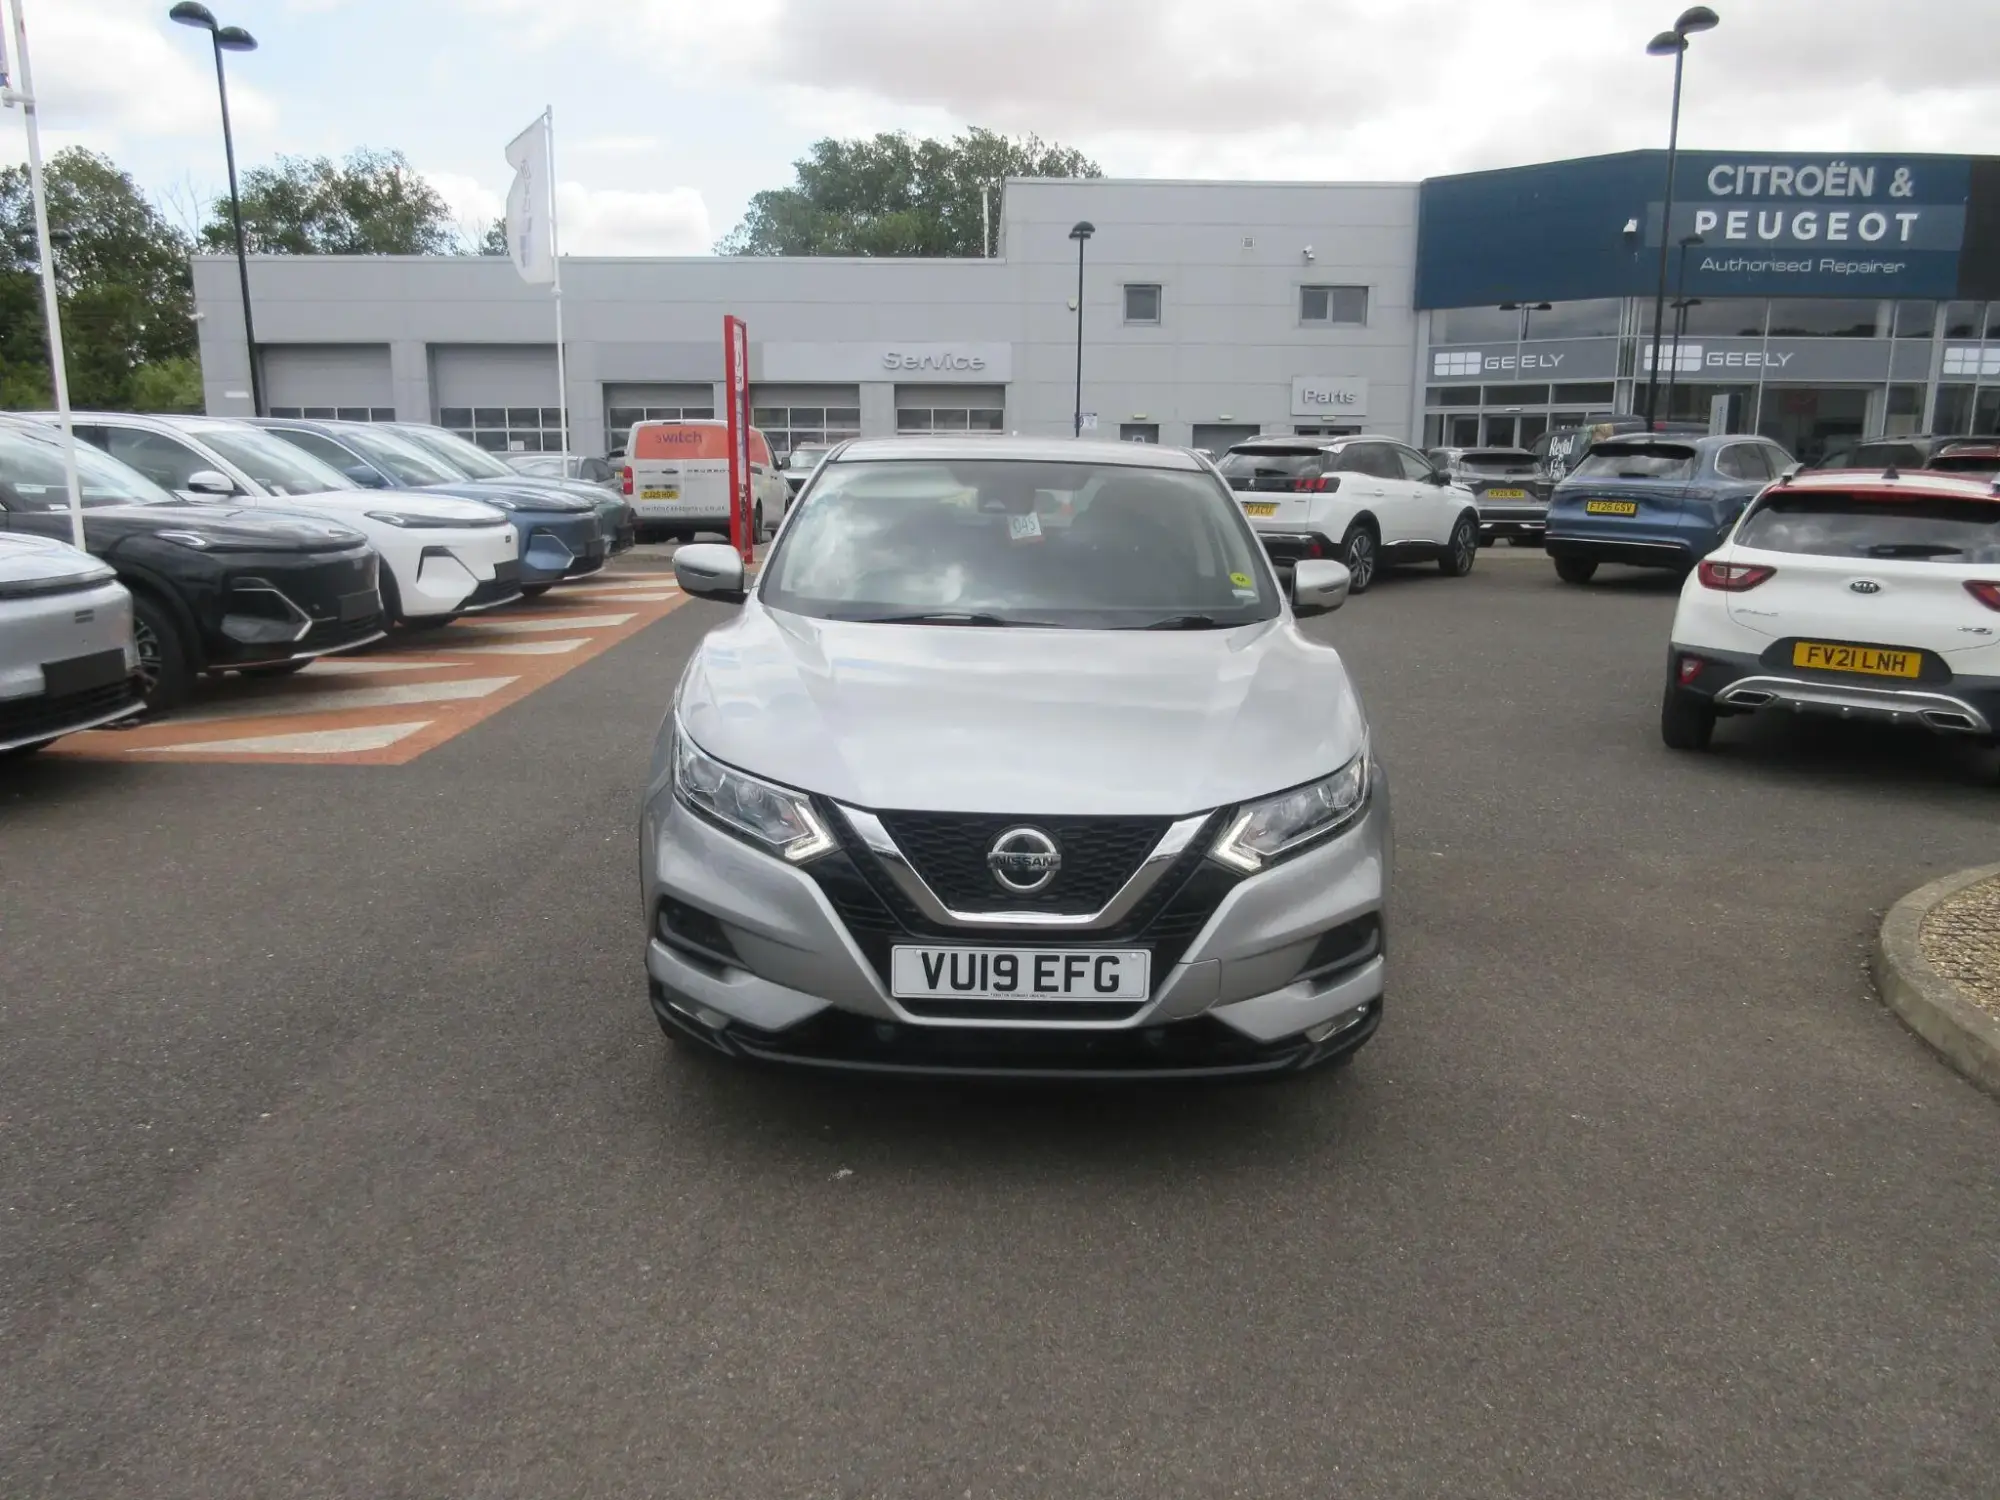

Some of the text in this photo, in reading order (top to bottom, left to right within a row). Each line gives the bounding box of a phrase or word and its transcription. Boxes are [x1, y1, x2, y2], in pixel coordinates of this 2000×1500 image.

[1707, 161, 1914, 197] CITROËN &
[1694, 210, 1918, 242] PEUGEOT
[1700, 257, 1907, 275] Authorised Repairer
[883, 351, 985, 371] Service
[1484, 353, 1564, 371] GEELY
[1706, 351, 1795, 367] GEELY
[1302, 388, 1357, 405] Parts
[655, 430, 703, 444] switch
[1807, 646, 1907, 672] FV21 LNH
[995, 855, 1054, 866] NISSAN
[921, 952, 1121, 993] VU19 EFG
